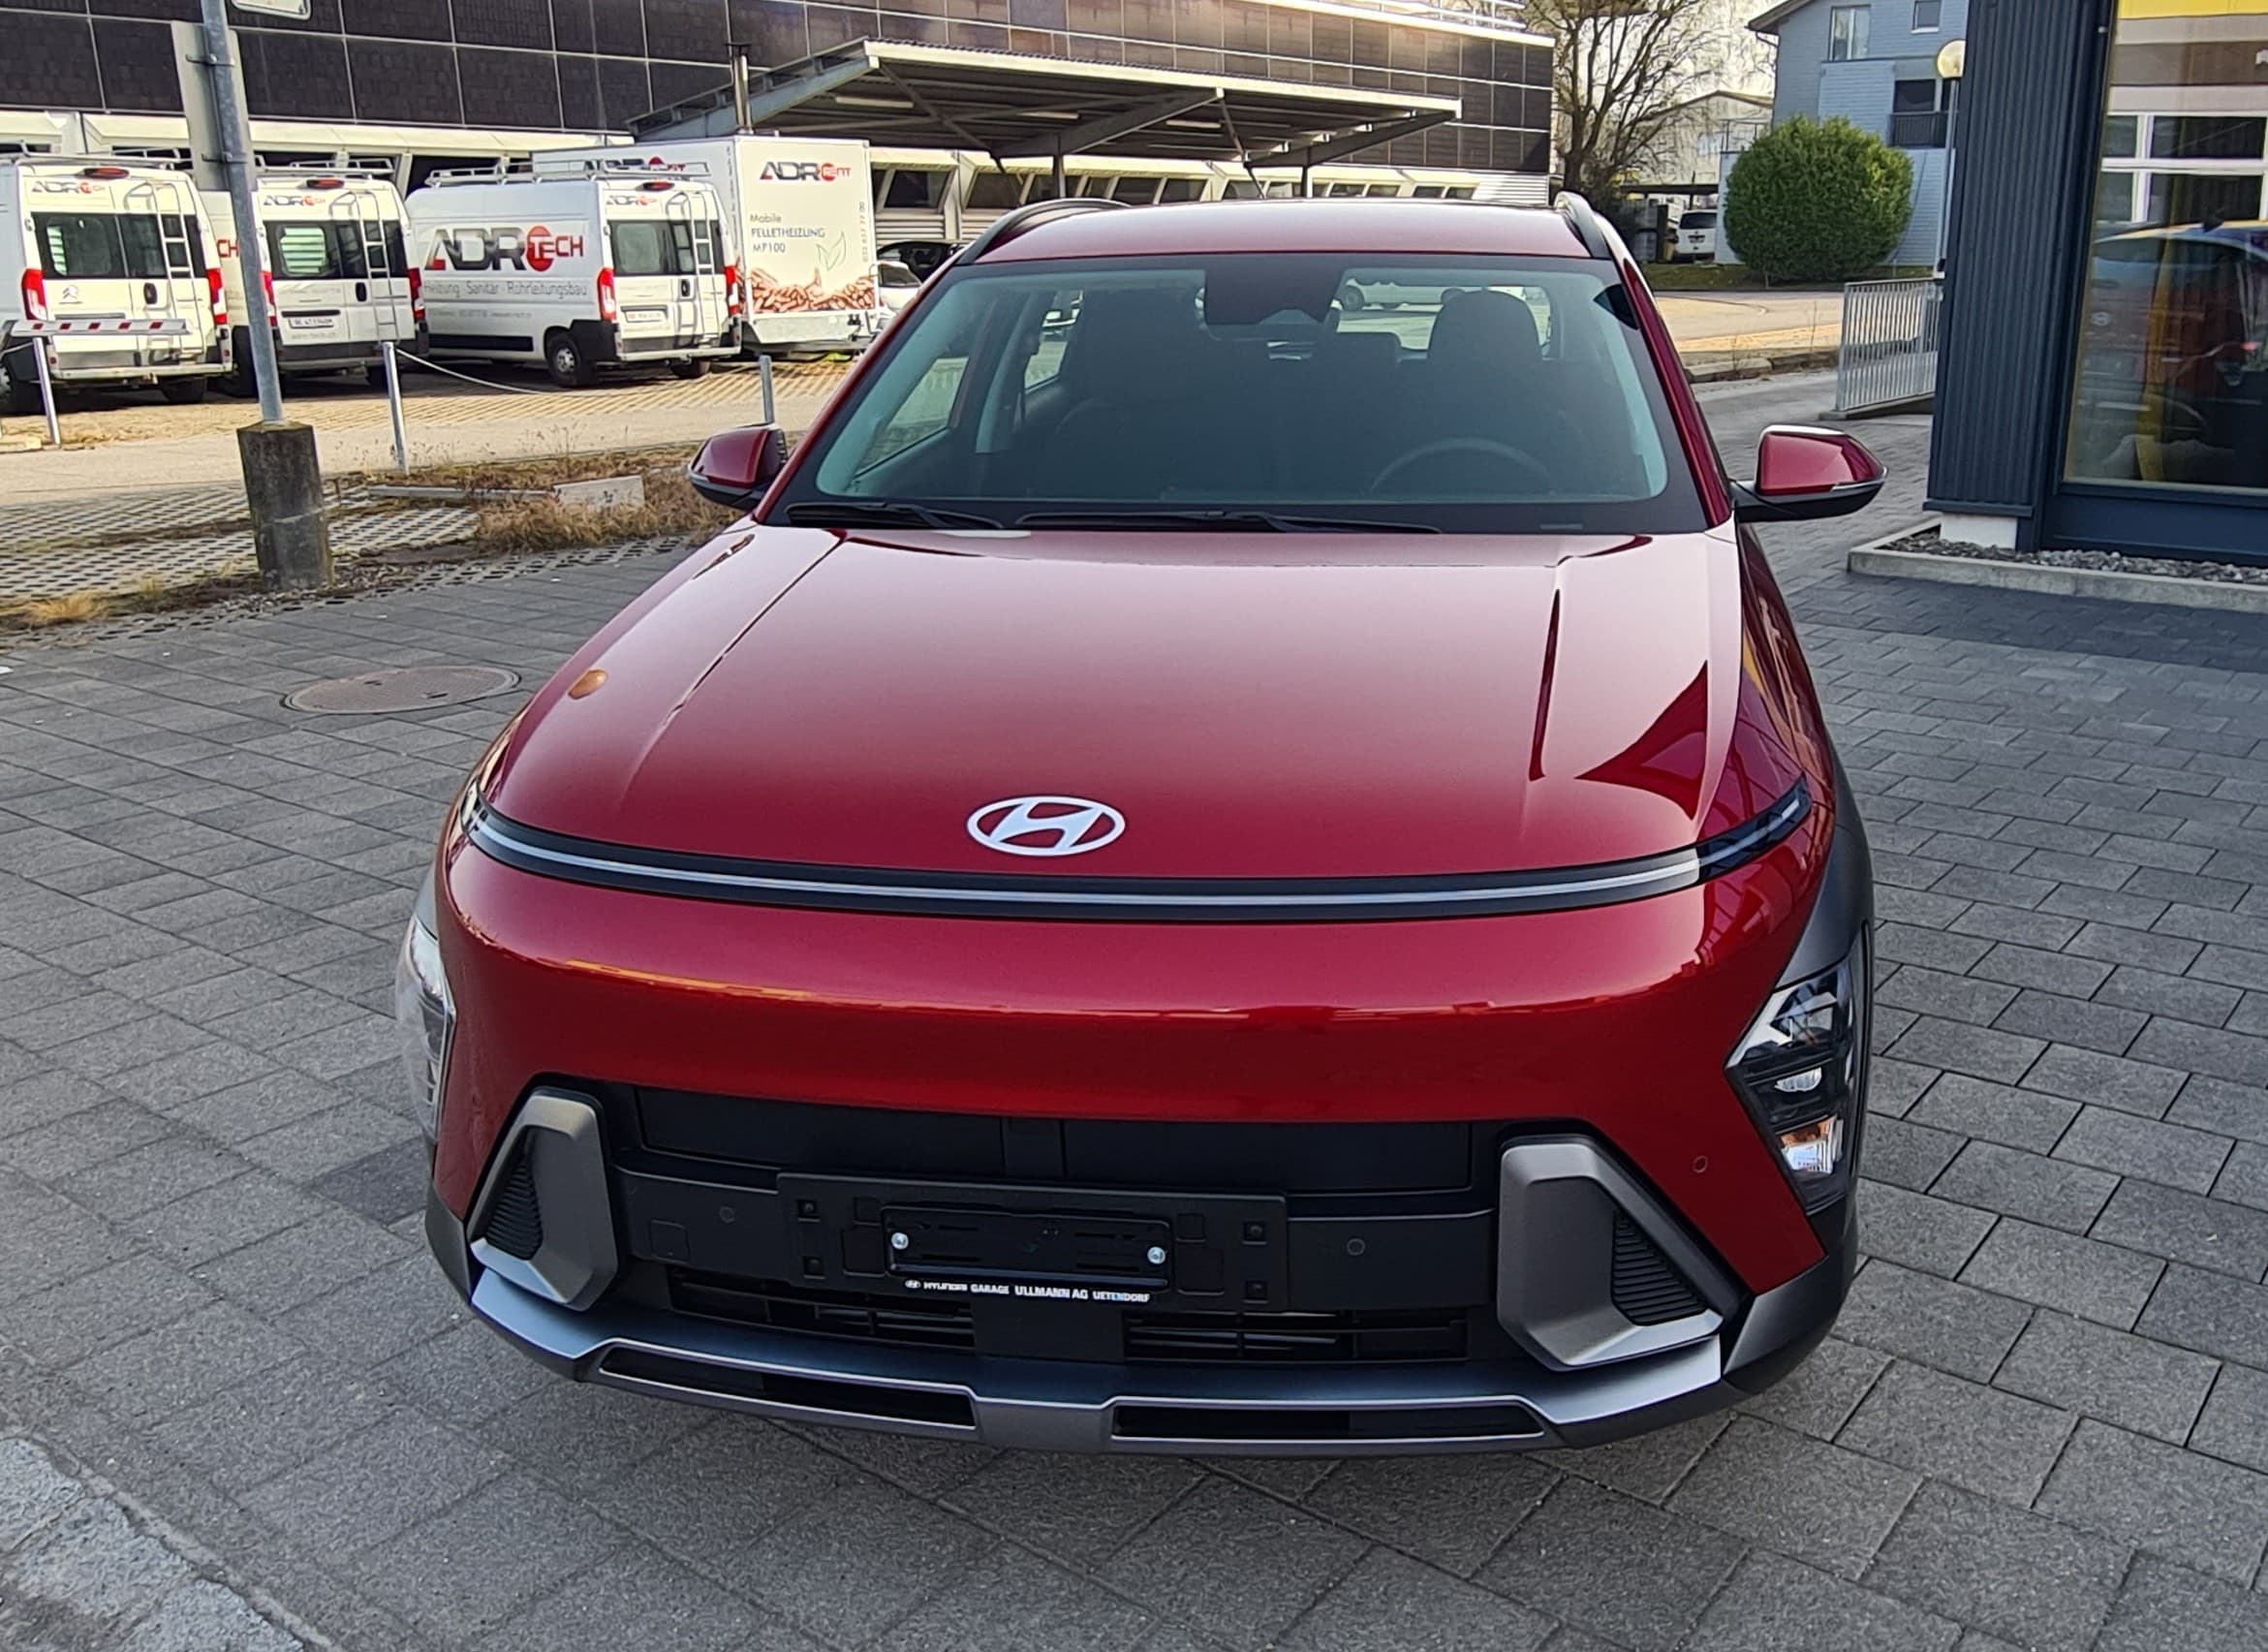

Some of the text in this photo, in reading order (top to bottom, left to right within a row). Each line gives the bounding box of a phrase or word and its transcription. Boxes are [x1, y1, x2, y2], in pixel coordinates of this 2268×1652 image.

[750, 213, 782, 223] Mobile
[751, 228, 825, 238] PELLETHEIZUNG
[971, 1284, 1010, 1294] GARAGE
[1014, 1286, 1070, 1298] ULLMANN
[1072, 1289, 1088, 1299] AG
[1092, 1291, 1150, 1303] UETENDORF
